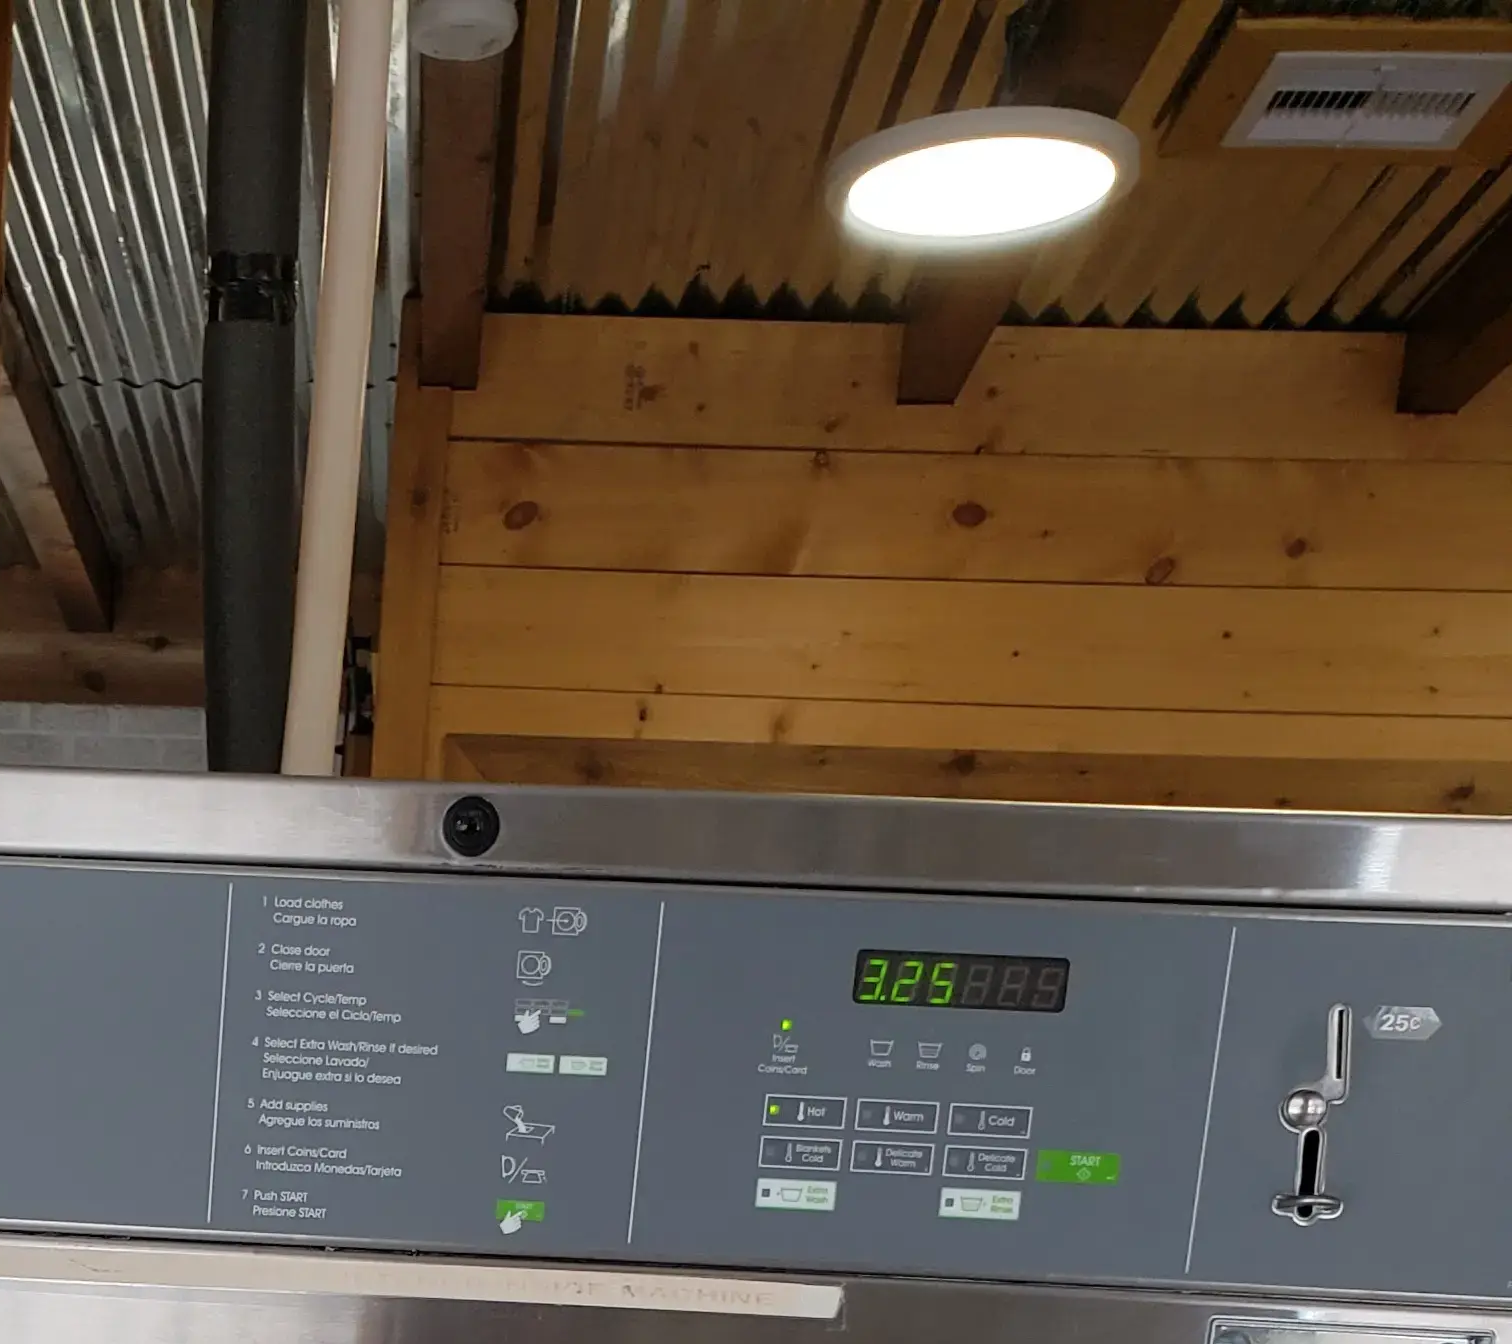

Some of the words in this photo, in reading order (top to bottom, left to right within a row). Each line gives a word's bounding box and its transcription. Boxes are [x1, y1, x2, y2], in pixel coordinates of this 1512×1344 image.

[262, 895, 267, 907] 1
[273, 895, 303, 908] Load
[303, 897, 344, 910] clothes
[271, 911, 315, 927] Cargue
[316, 913, 328, 925] la
[329, 916, 357, 928] ropa
[257, 942, 266, 954] 2
[270, 943, 302, 956] Close
[303, 944, 331, 957] door
[269, 958, 303, 971] Cierre
[304, 960, 316, 972] la
[317, 961, 355, 975] puerta
[859, 958, 956, 1005] 3.25
[254, 989, 262, 1000] 3
[267, 989, 301, 1002] Select
[302, 991, 367, 1007] Cycle/Temp
[265, 1005, 327, 1019] Seleccione
[327, 1008, 339, 1020] el
[340, 1008, 402, 1024] Ciclo/Temp
[251, 1036, 259, 1046] 4
[263, 1036, 298, 1049] Select
[299, 1037, 326, 1050] Extra
[326, 1039, 387, 1053] Wash/Rinse
[396, 1042, 438, 1055] desired
[262, 1051, 324, 1066] Seleccione
[771, 1053, 796, 1063] Insert
[915, 1060, 939, 1070] Rinse
[965, 1062, 986, 1073] Spin
[261, 1067, 313, 1083] Enjuague
[314, 1070, 343, 1082] extra
[343, 1072, 352, 1082] si
[353, 1072, 365, 1083] lo
[365, 1072, 402, 1085] desea
[246, 1097, 255, 1108] 5
[259, 1098, 283, 1110] Add
[284, 1099, 328, 1114] supplies
[806, 1106, 825, 1117] Hot
[257, 1113, 306, 1129] Agregue
[306, 1115, 323, 1127] los
[323, 1116, 380, 1130] suministros
[892, 1110, 924, 1122] Warm
[987, 1115, 1015, 1126] Cold
[243, 1143, 252, 1154] 6
[256, 1144, 285, 1156] Insert
[286, 1145, 347, 1159] Coins/Card
[801, 1153, 824, 1162] Cold
[885, 1147, 923, 1158] Delicate
[977, 1152, 1016, 1163] Delicate
[255, 1159, 312, 1172] Introduzca
[313, 1161, 402, 1178] Monedas/Tarjeta
[889, 1158, 916, 1167] Warm
[983, 1162, 1007, 1172] Cold
[1069, 1154, 1102, 1168] START
[240, 1188, 249, 1200] 7
[253, 1189, 278, 1201] Push
[279, 1190, 308, 1203] START
[252, 1204, 297, 1217] Presione
[297, 1206, 327, 1219] START
